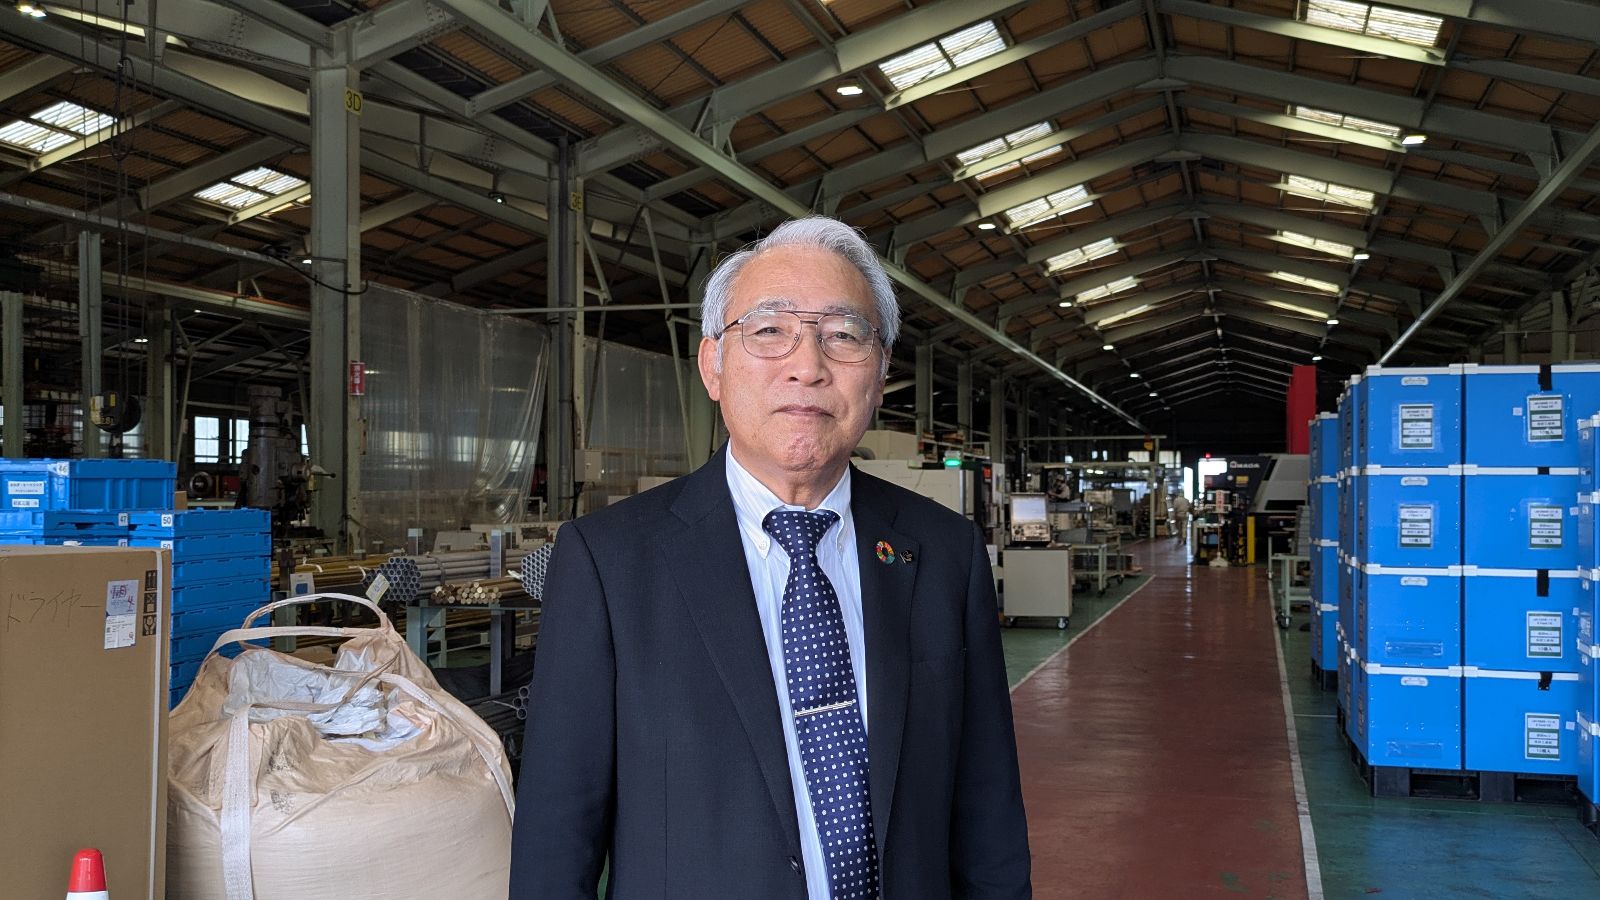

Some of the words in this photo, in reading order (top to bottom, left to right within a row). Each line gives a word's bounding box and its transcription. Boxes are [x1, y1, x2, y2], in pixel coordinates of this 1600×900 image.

[346, 90, 362, 111] 3D
[572, 193, 582, 209] 3E
[162, 516, 172, 525] 50
[7, 589, 103, 633] ドライヤー
